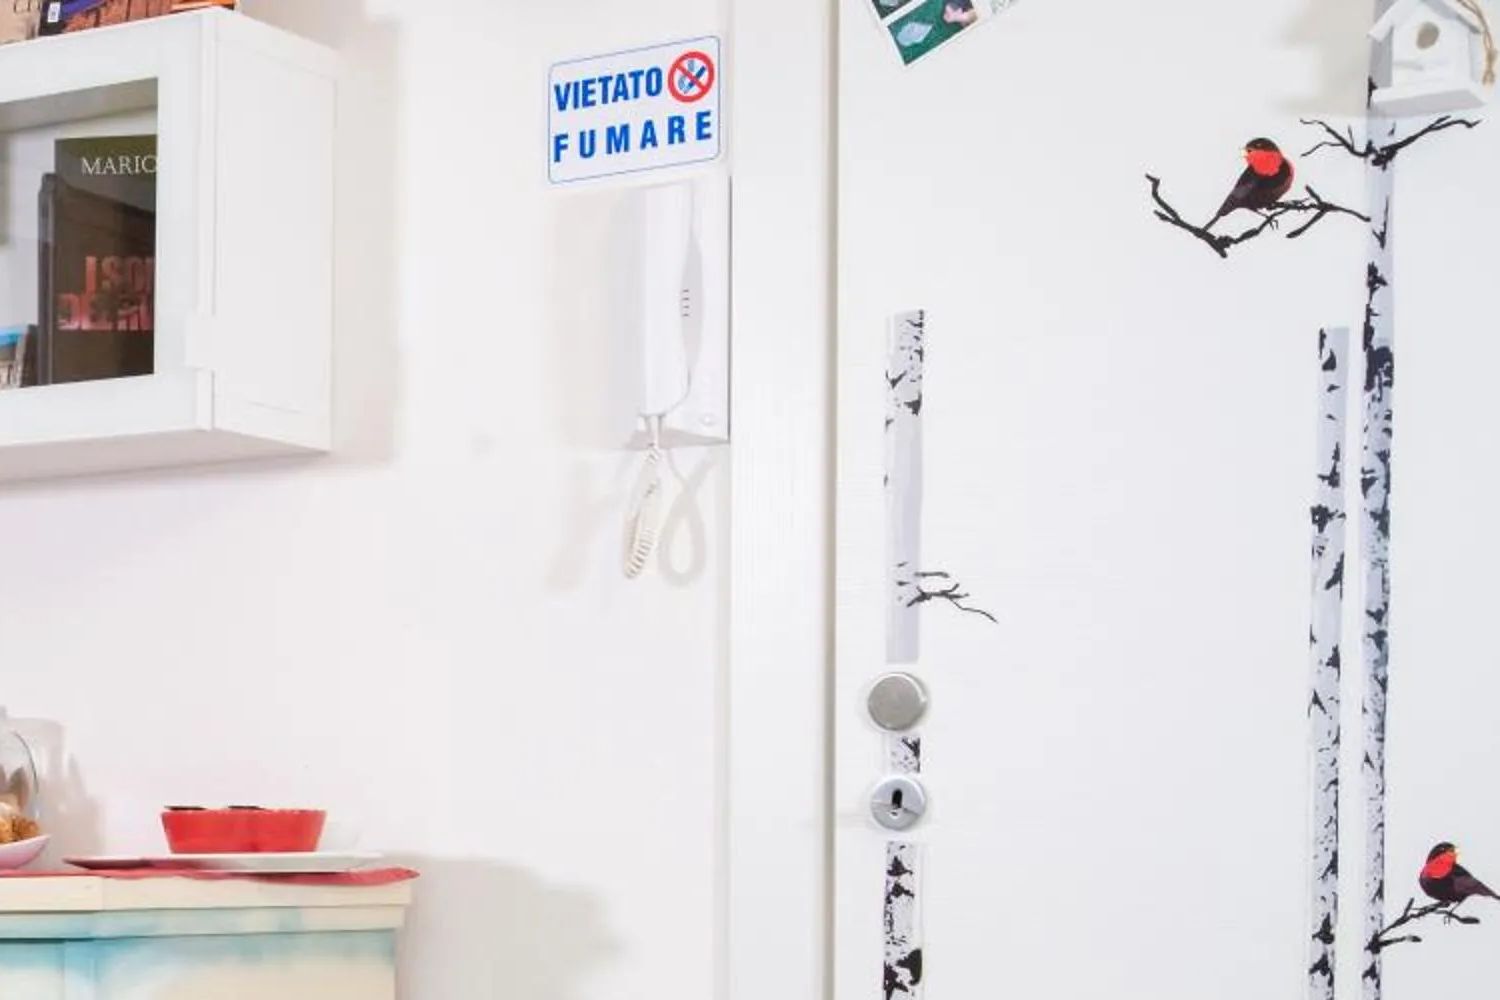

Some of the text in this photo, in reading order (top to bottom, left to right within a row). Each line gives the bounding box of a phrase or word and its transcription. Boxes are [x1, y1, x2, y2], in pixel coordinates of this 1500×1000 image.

[553, 66, 663, 112] VIETATO
[553, 110, 712, 163] FUMARE
[81, 155, 157, 176] MARIO
